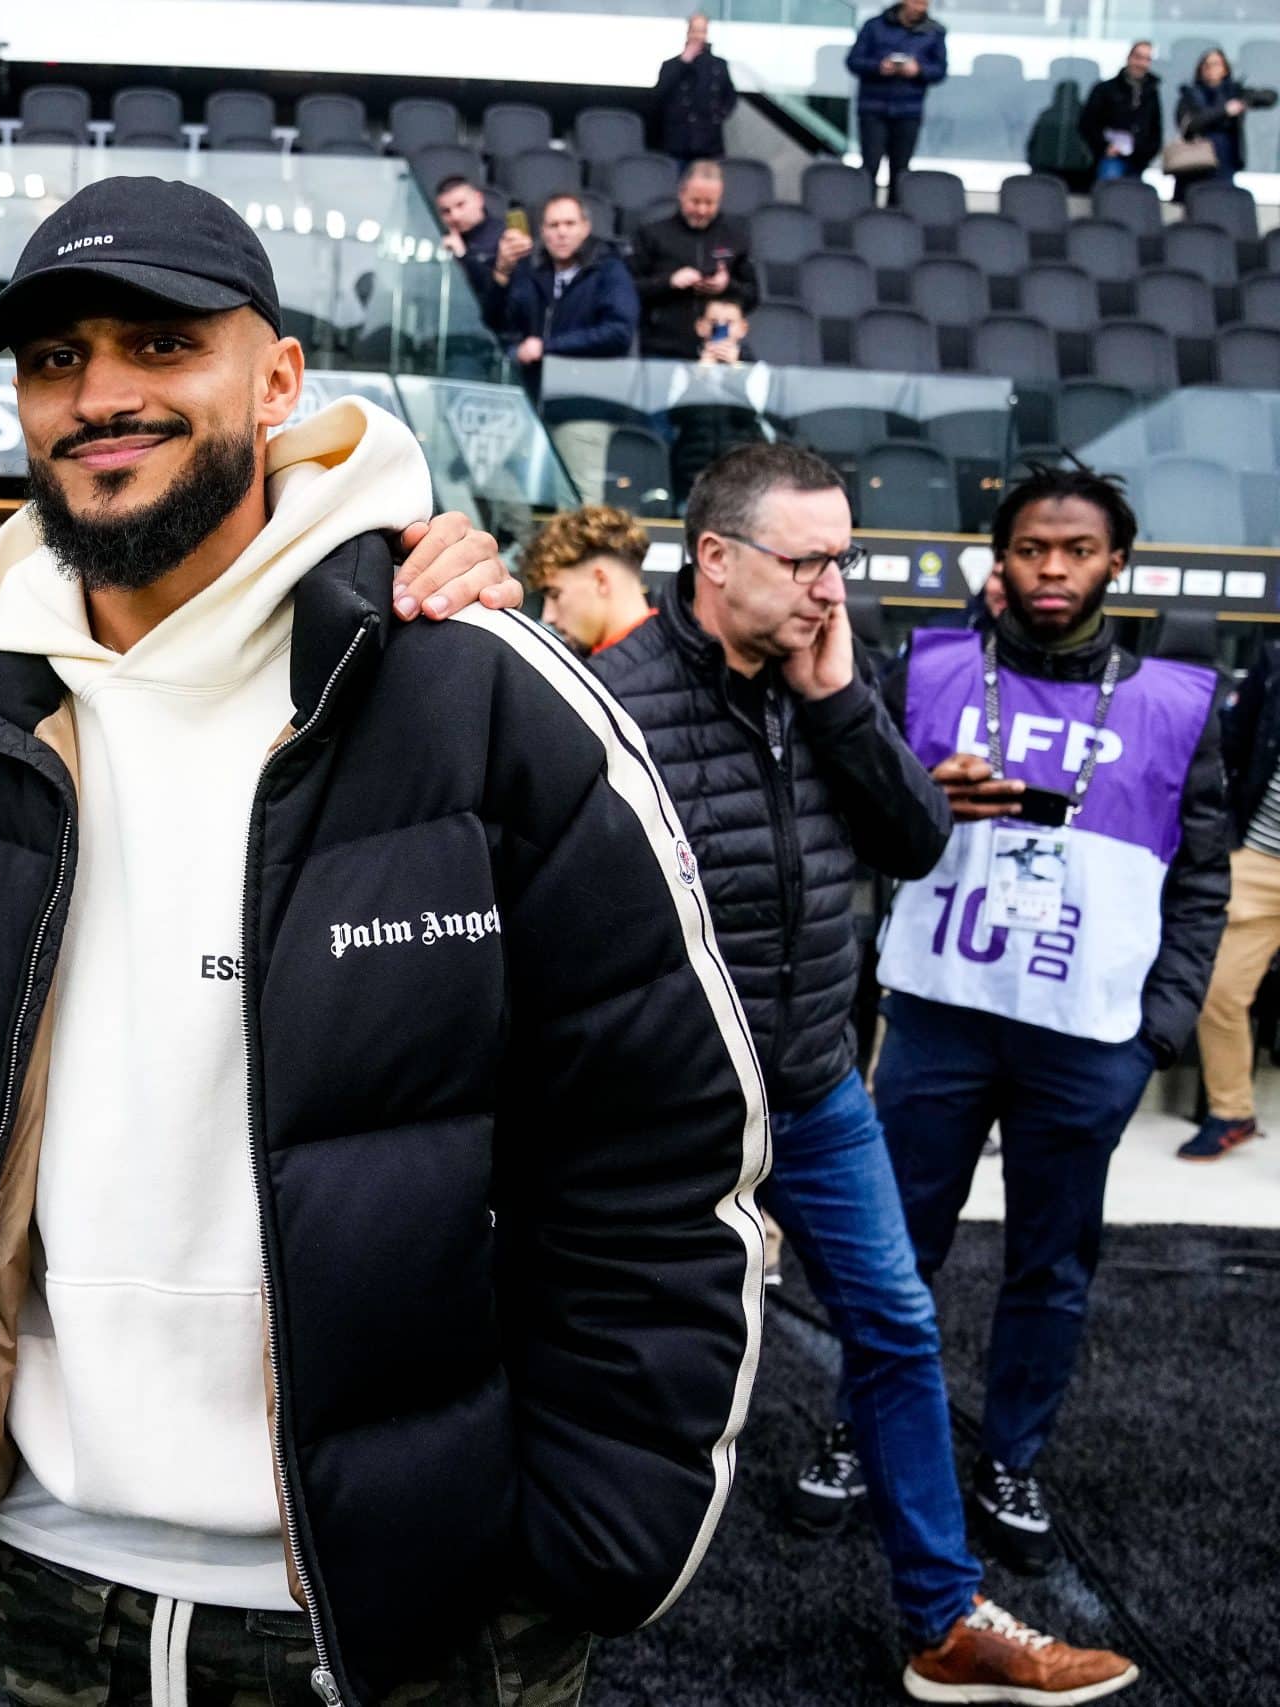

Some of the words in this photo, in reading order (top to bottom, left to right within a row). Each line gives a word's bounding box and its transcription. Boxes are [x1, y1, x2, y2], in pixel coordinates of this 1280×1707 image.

[57, 235, 114, 256] SANDRO
[955, 705, 1124, 773] LFP
[330, 917, 415, 959] Palm
[931, 881, 1010, 964] 10
